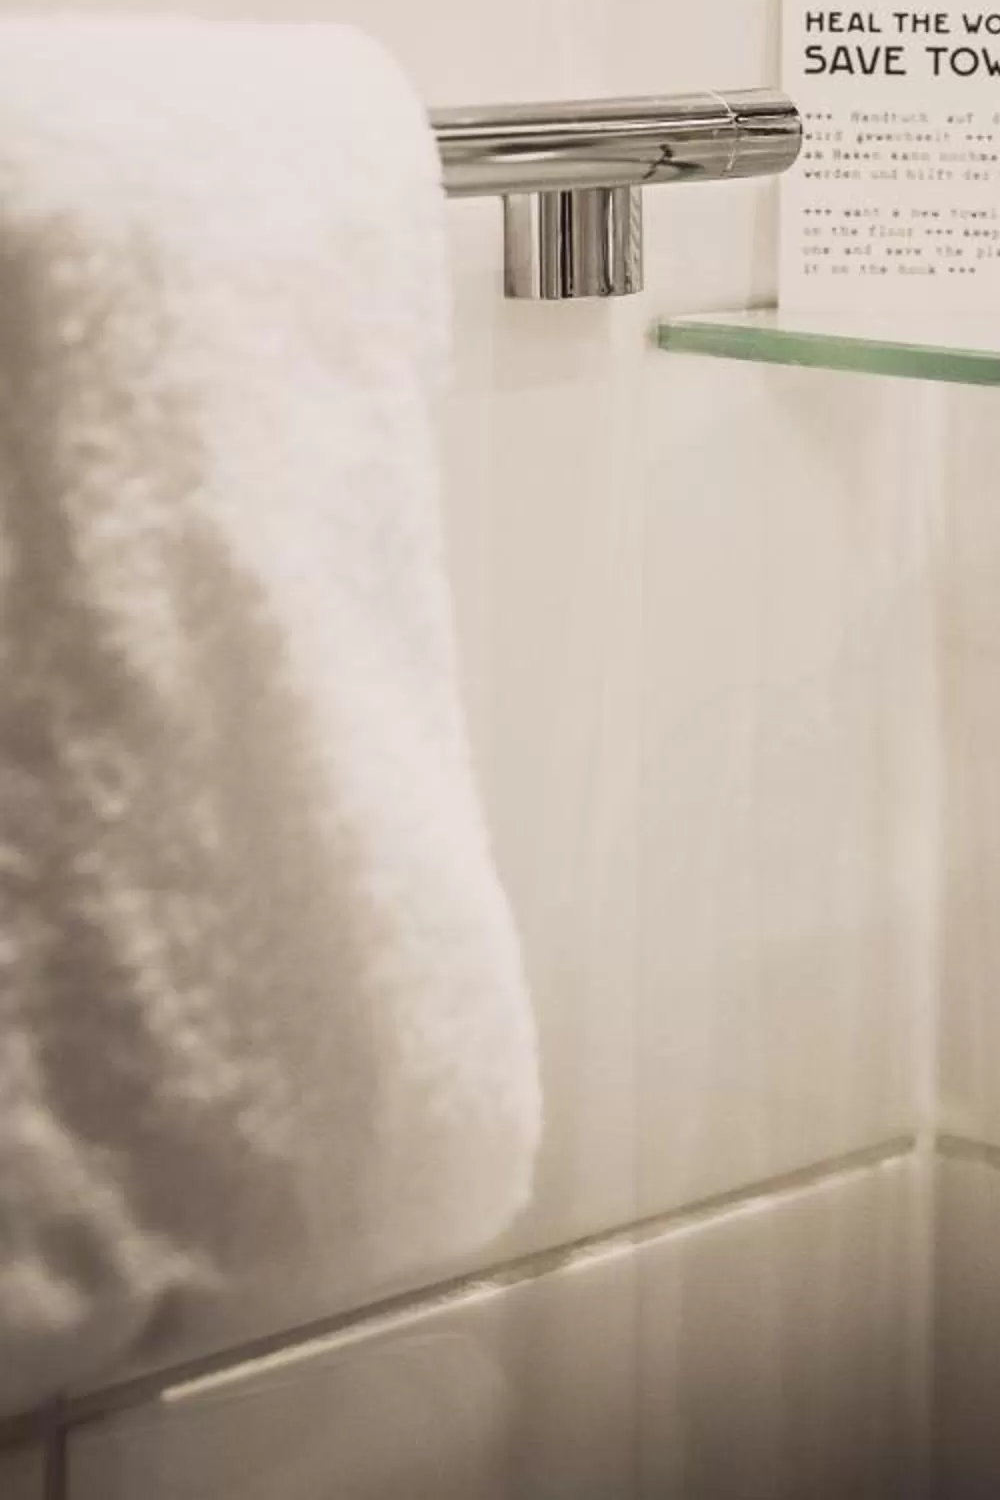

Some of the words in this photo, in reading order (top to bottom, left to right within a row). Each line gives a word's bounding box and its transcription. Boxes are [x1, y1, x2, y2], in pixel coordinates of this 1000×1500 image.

[805, 11, 883, 33] HEAL
[892, 12, 951, 35] THE
[803, 45, 908, 76] SAVE
